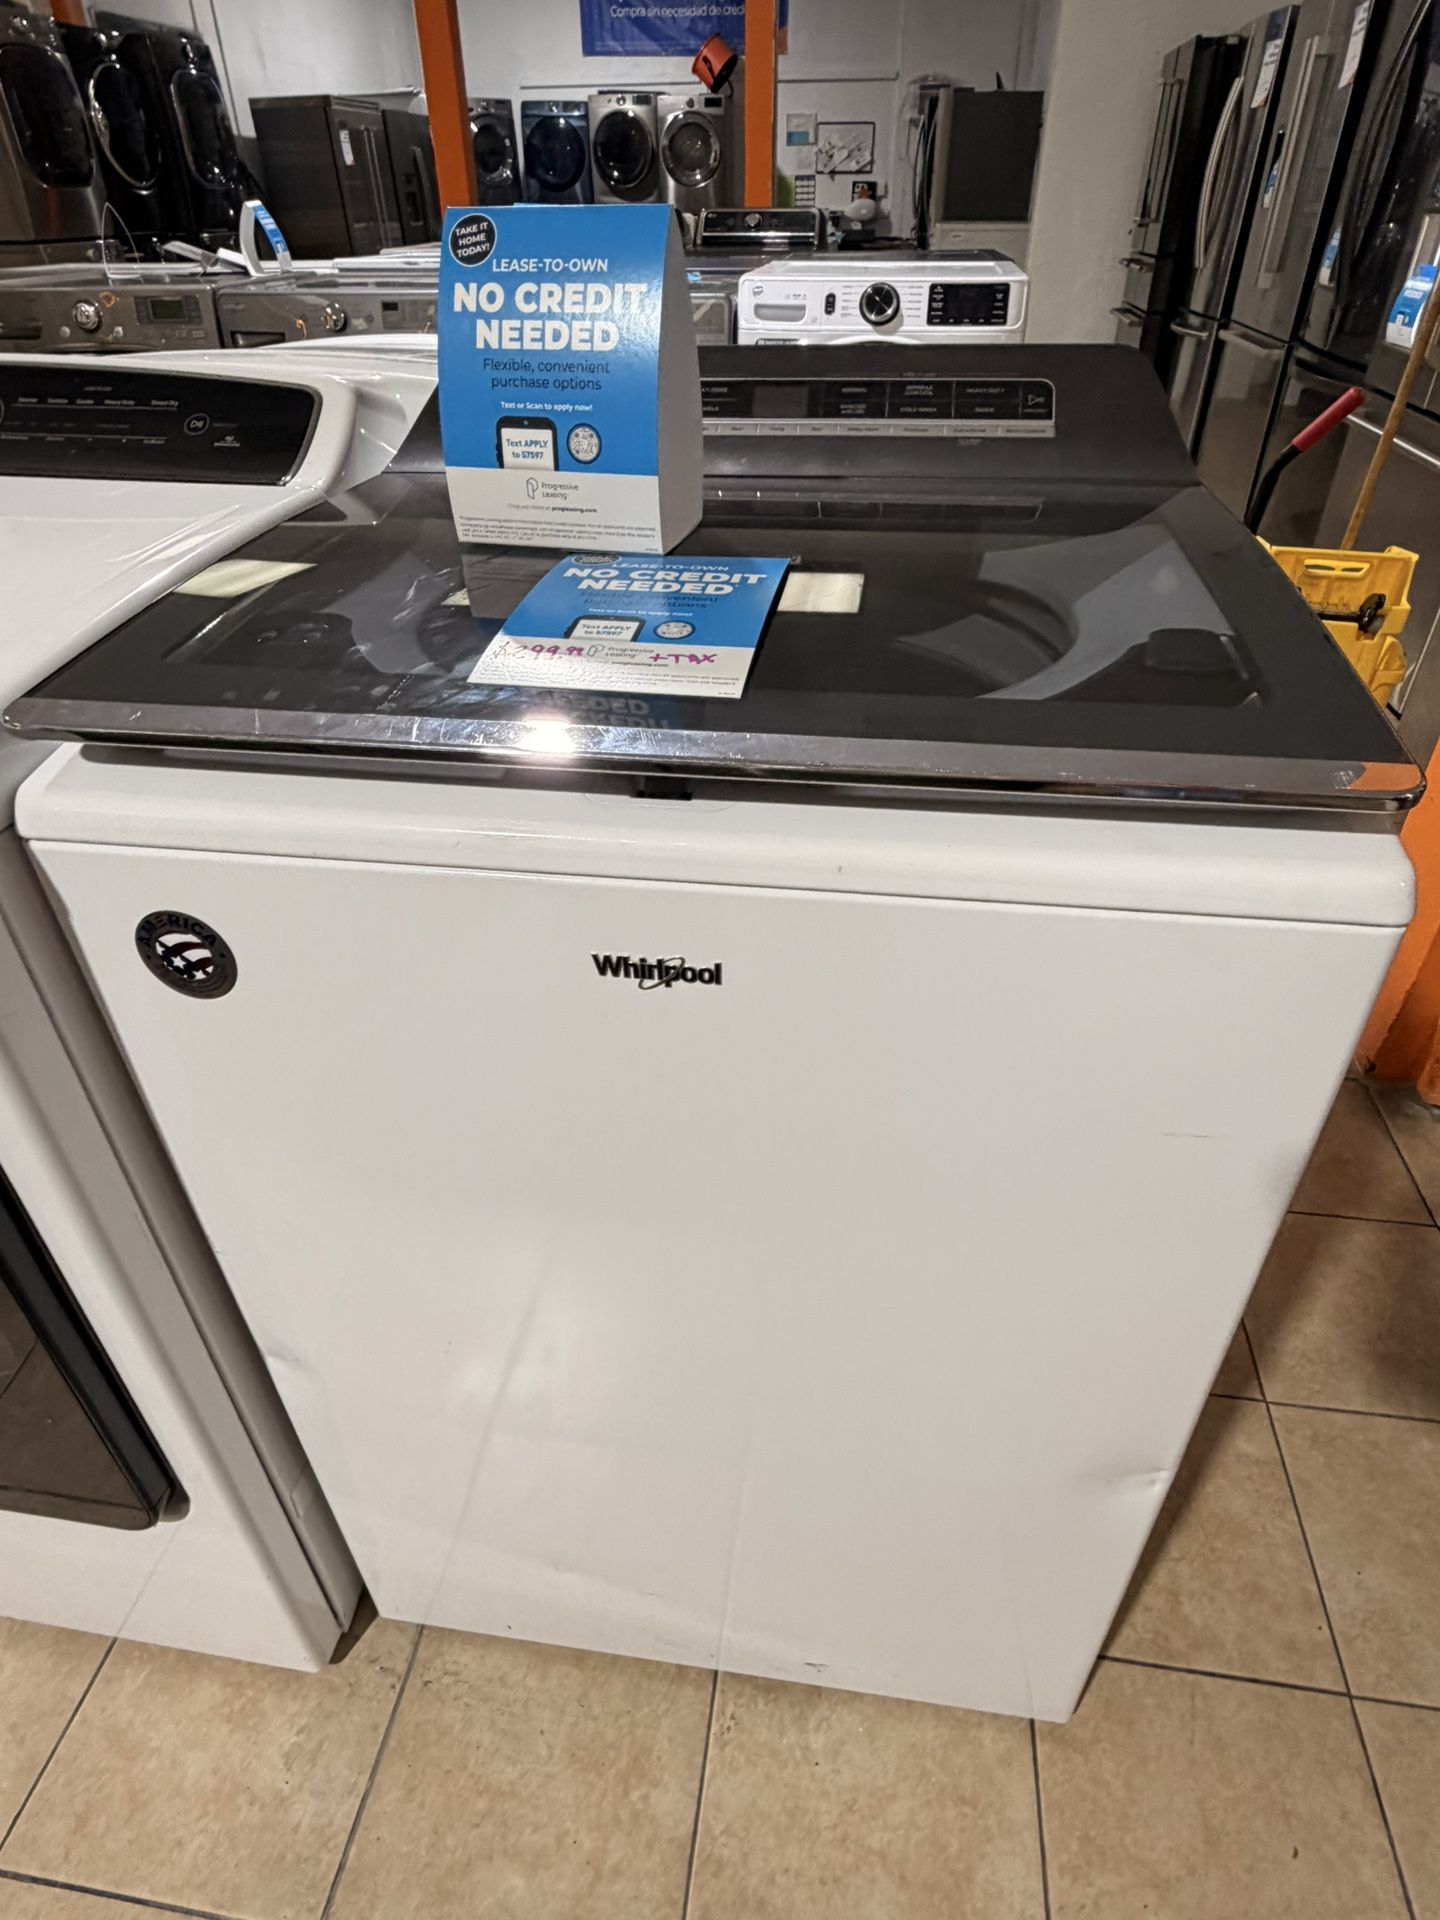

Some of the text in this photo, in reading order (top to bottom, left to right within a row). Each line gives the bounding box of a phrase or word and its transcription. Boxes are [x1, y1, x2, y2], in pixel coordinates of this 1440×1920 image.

[610, 5, 646, 18] Compra
[661, 4, 707, 17] necesidad
[455, 221, 489, 236] TAKE IT
[458, 233, 487, 246] HOME
[456, 243, 490, 258] TODAY!
[492, 258, 609, 272] LEASE-TO-OWN
[453, 282, 648, 314] NO CREDIT
[475, 319, 620, 352] NEEDED
[483, 358, 611, 374] Flexible, convenient
[491, 375, 603, 391] purchase options
[500, 401, 515, 409] Text
[525, 402, 543, 410] Scan
[554, 403, 574, 413] apply
[506, 438, 548, 448] Text APPLY
[512, 450, 520, 458] to
[541, 482, 579, 491] Progressive
[542, 491, 567, 500] Leasing
[611, 563, 729, 572] LEASE-TO-OWN
[563, 567, 767, 584] NO CREDIT
[591, 953, 722, 990] Whirlpool
